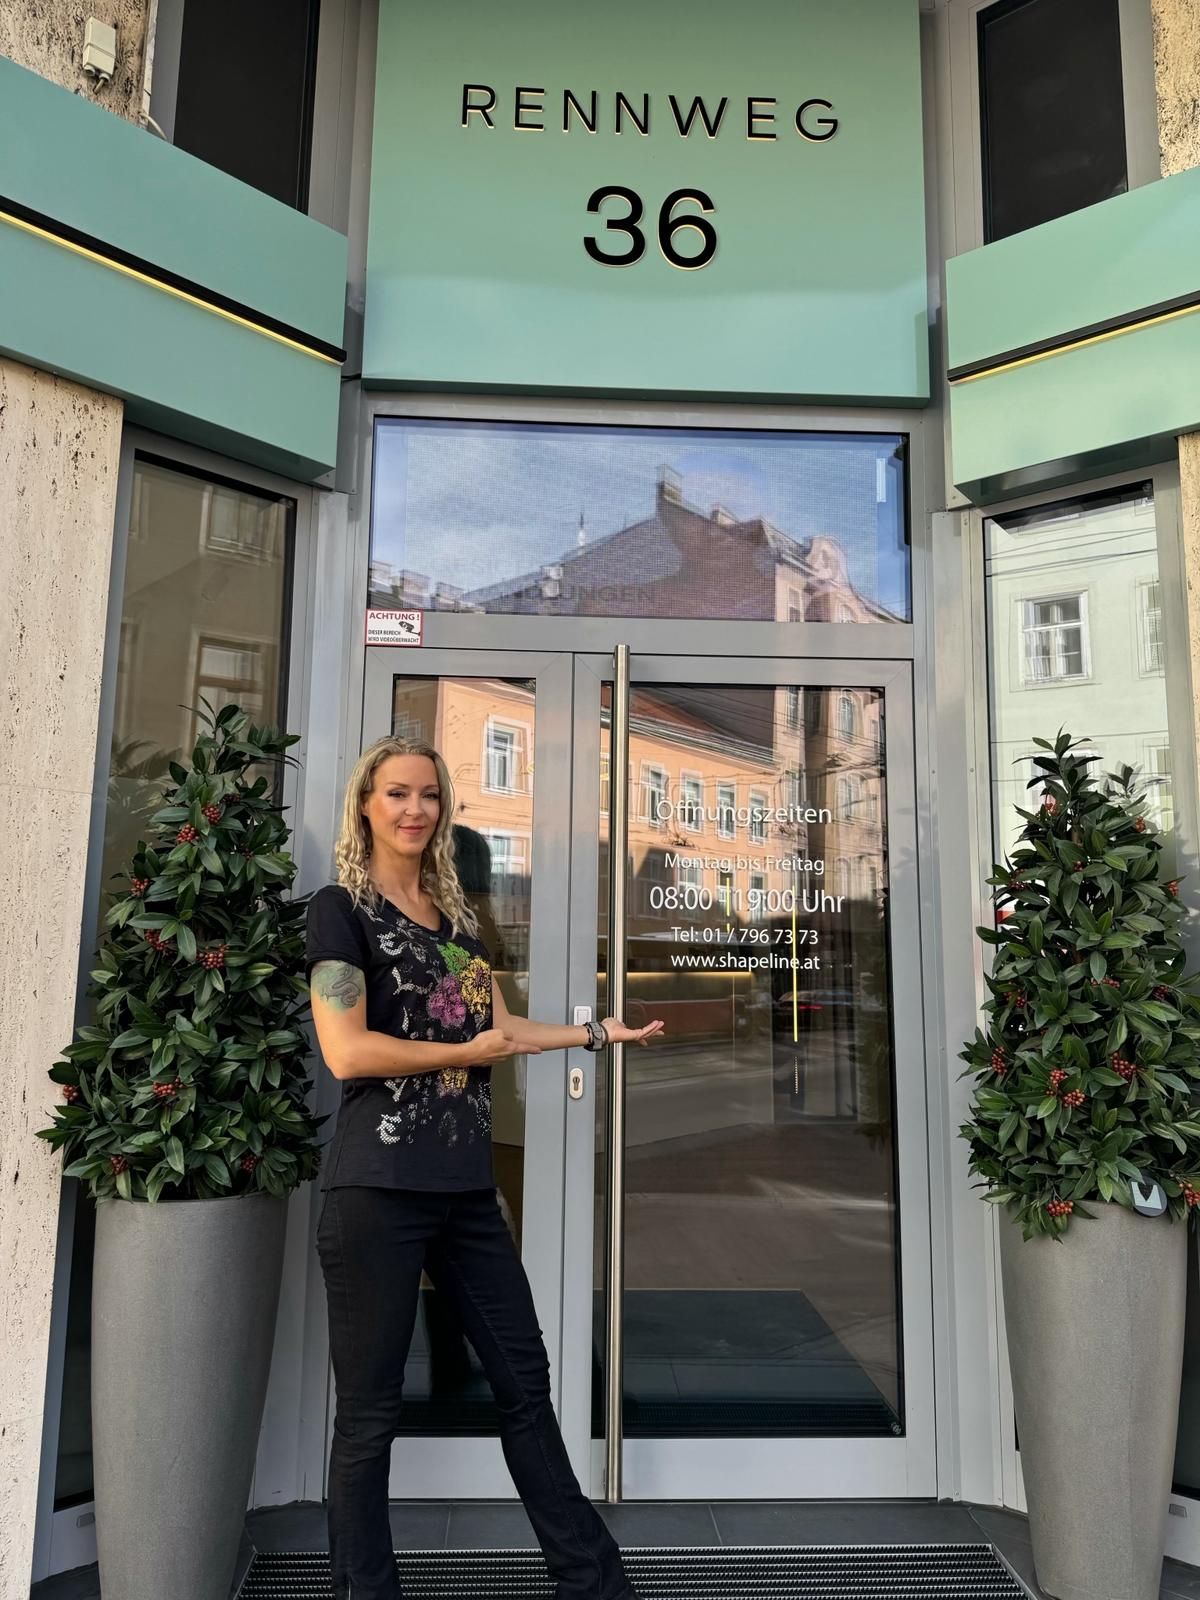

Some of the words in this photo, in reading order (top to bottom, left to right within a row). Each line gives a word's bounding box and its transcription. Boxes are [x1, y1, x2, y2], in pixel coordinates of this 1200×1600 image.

[461, 84, 839, 142] RENNWEG
[583, 185, 718, 271] 36
[656, 797, 832, 826] Öffnungszeiten
[665, 853, 732, 873] Montag
[737, 854, 761, 870] bis
[767, 855, 824, 875] Freitag
[650, 886, 713, 910] 08:00
[735, 888, 796, 912] 19:00
[802, 889, 845, 913] Uhr
[671, 927, 699, 942] Tel:
[702, 927, 721, 943] 01
[726, 928, 735, 943] /
[739, 928, 770, 944] 796
[774, 929, 793, 944] 73
[799, 929, 819, 945] 73
[671, 952, 821, 972] www.shapeline.at
